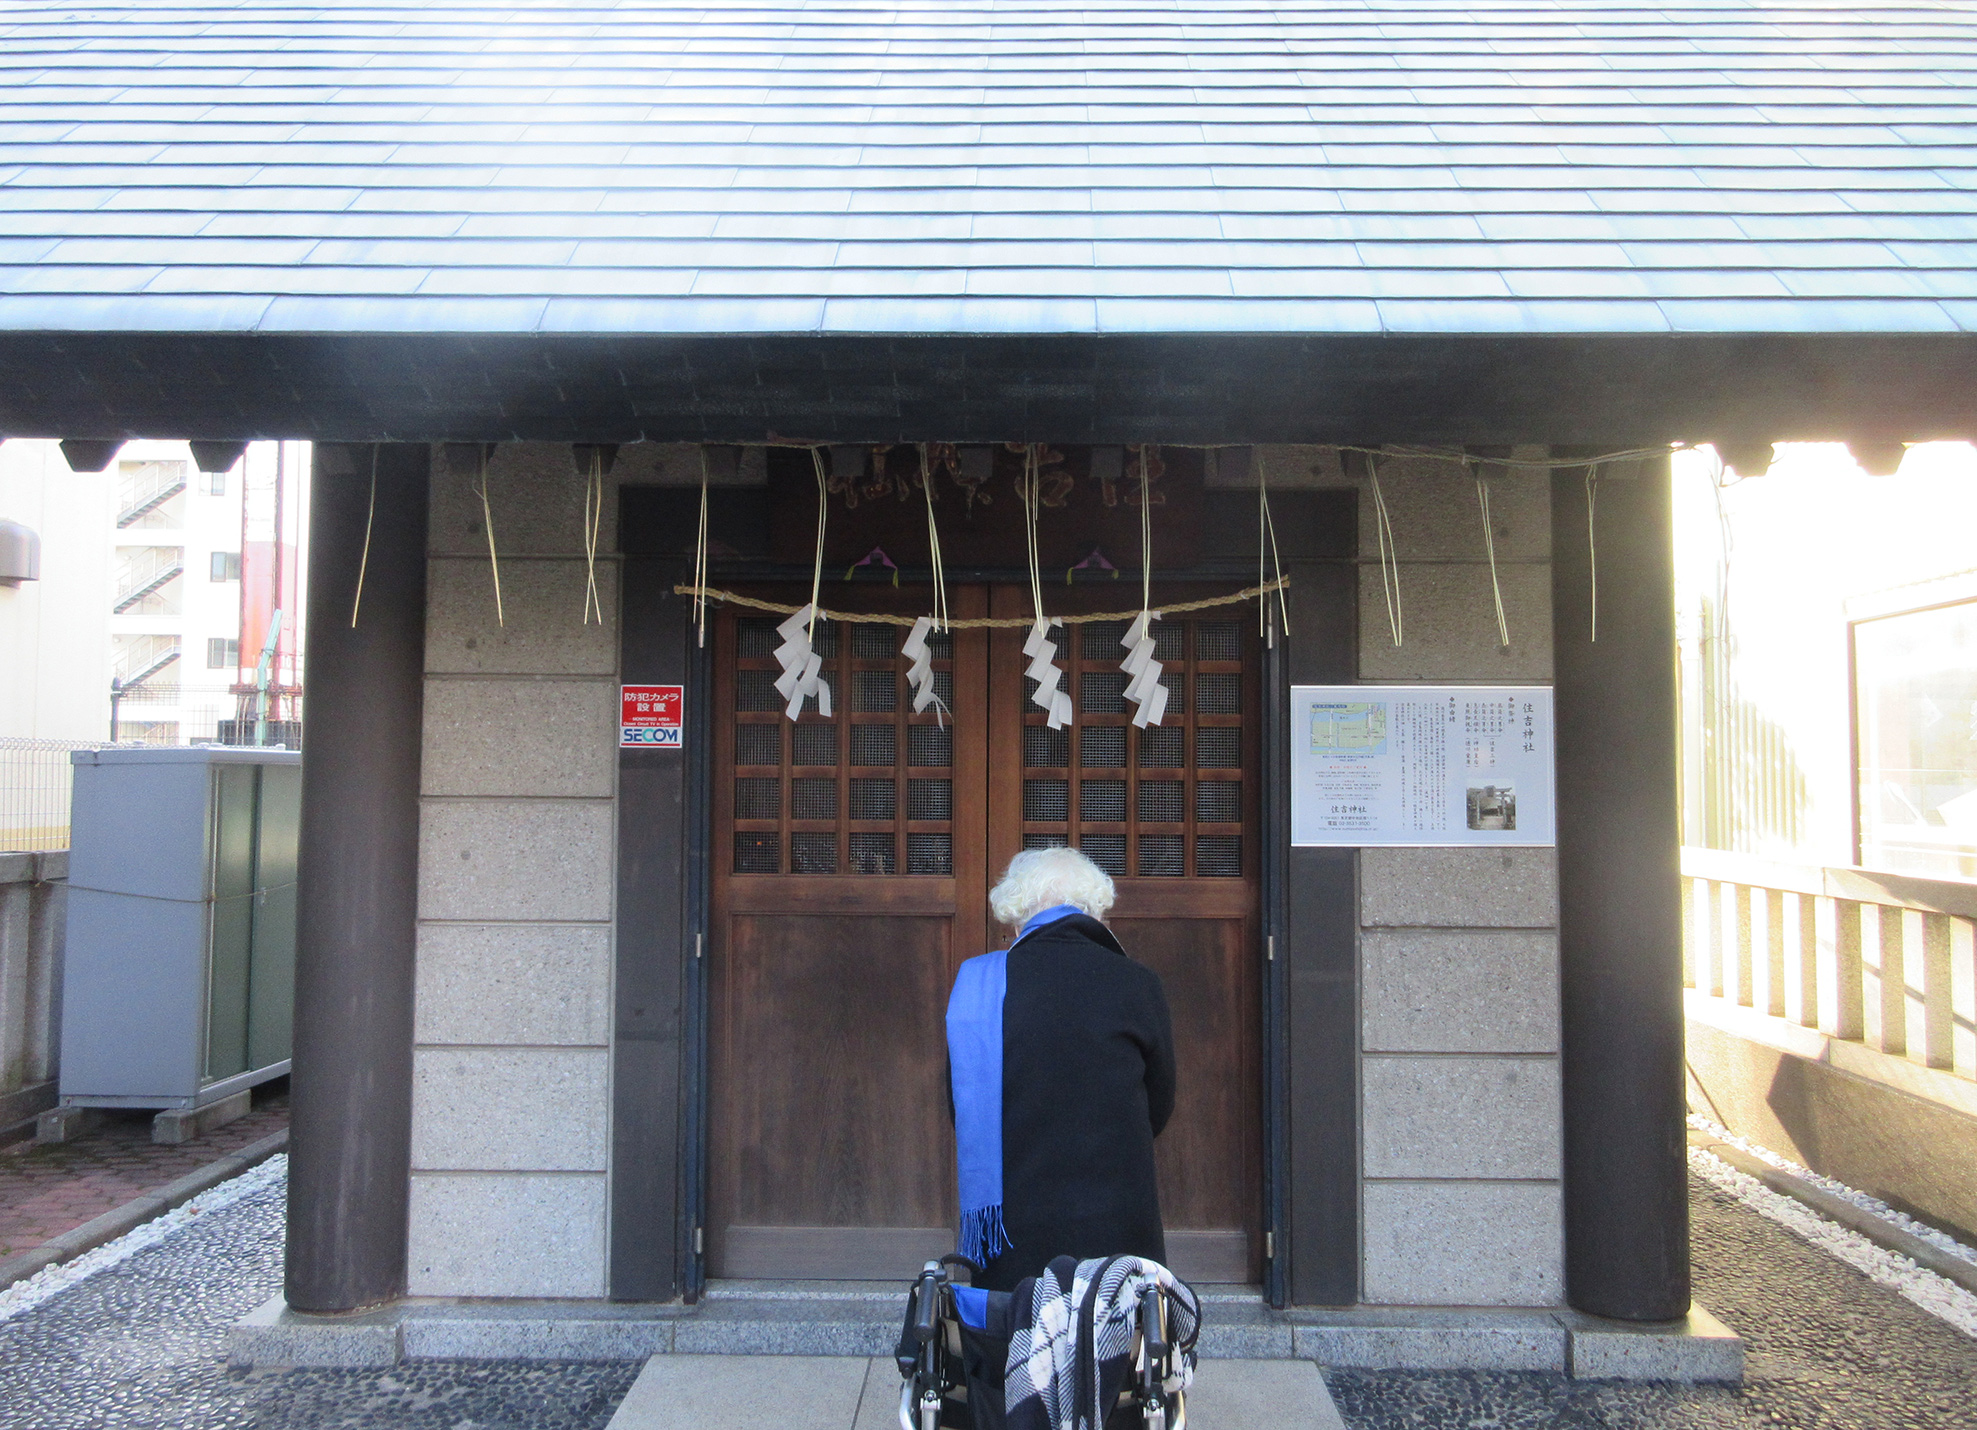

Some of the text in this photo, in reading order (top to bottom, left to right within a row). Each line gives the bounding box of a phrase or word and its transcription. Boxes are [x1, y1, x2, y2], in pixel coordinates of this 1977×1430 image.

[624, 693, 679, 702] 防犯カメラ
[637, 703, 666, 712] 設置
[1523, 703, 1535, 752] 住吉神社
[624, 728, 678, 742] SECOM
[1331, 805, 1368, 814] 住吉神社
